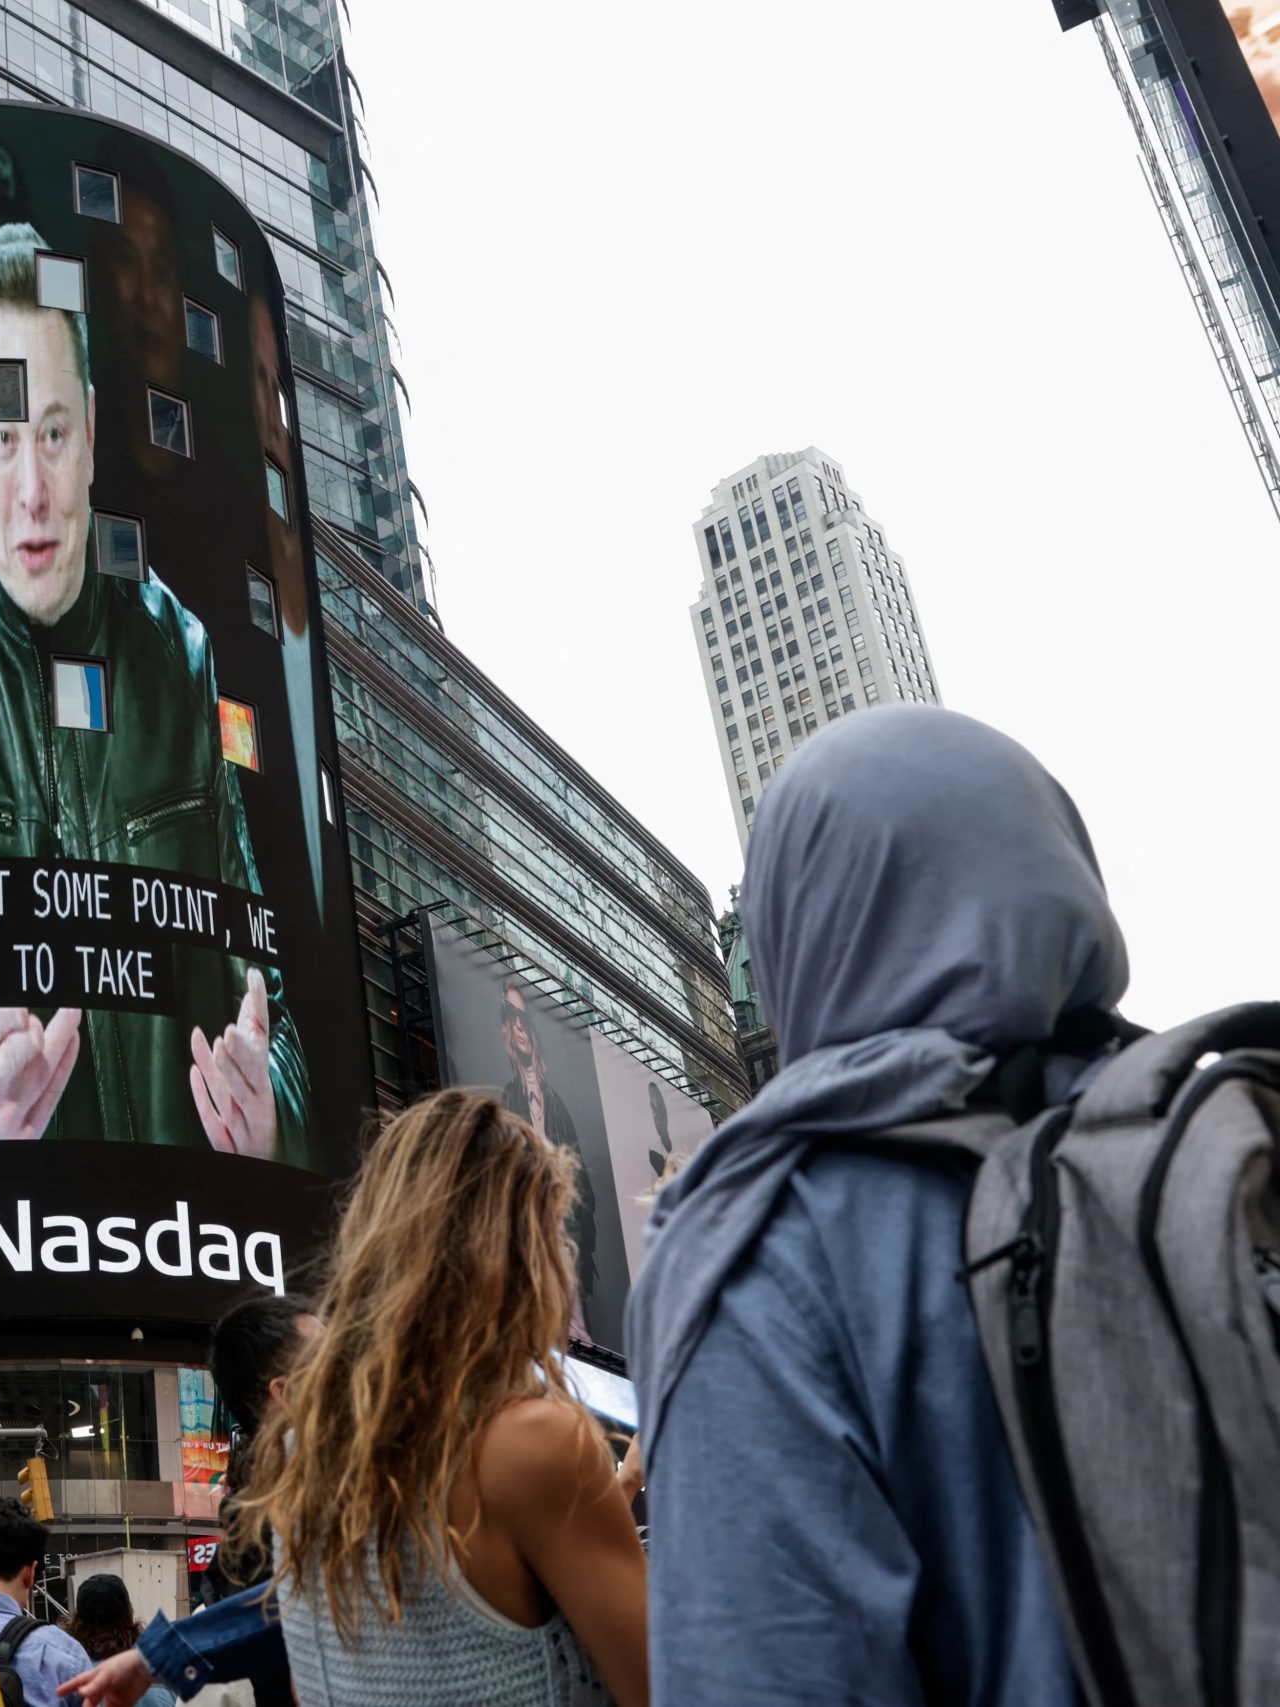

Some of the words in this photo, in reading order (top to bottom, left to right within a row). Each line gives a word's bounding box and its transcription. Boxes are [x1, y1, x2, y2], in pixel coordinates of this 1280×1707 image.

[33, 868, 112, 920] SOME
[132, 879, 231, 948] POINT,
[247, 903, 278, 956] WE
[13, 942, 54, 994] TO
[75, 946, 155, 999] TAKE
